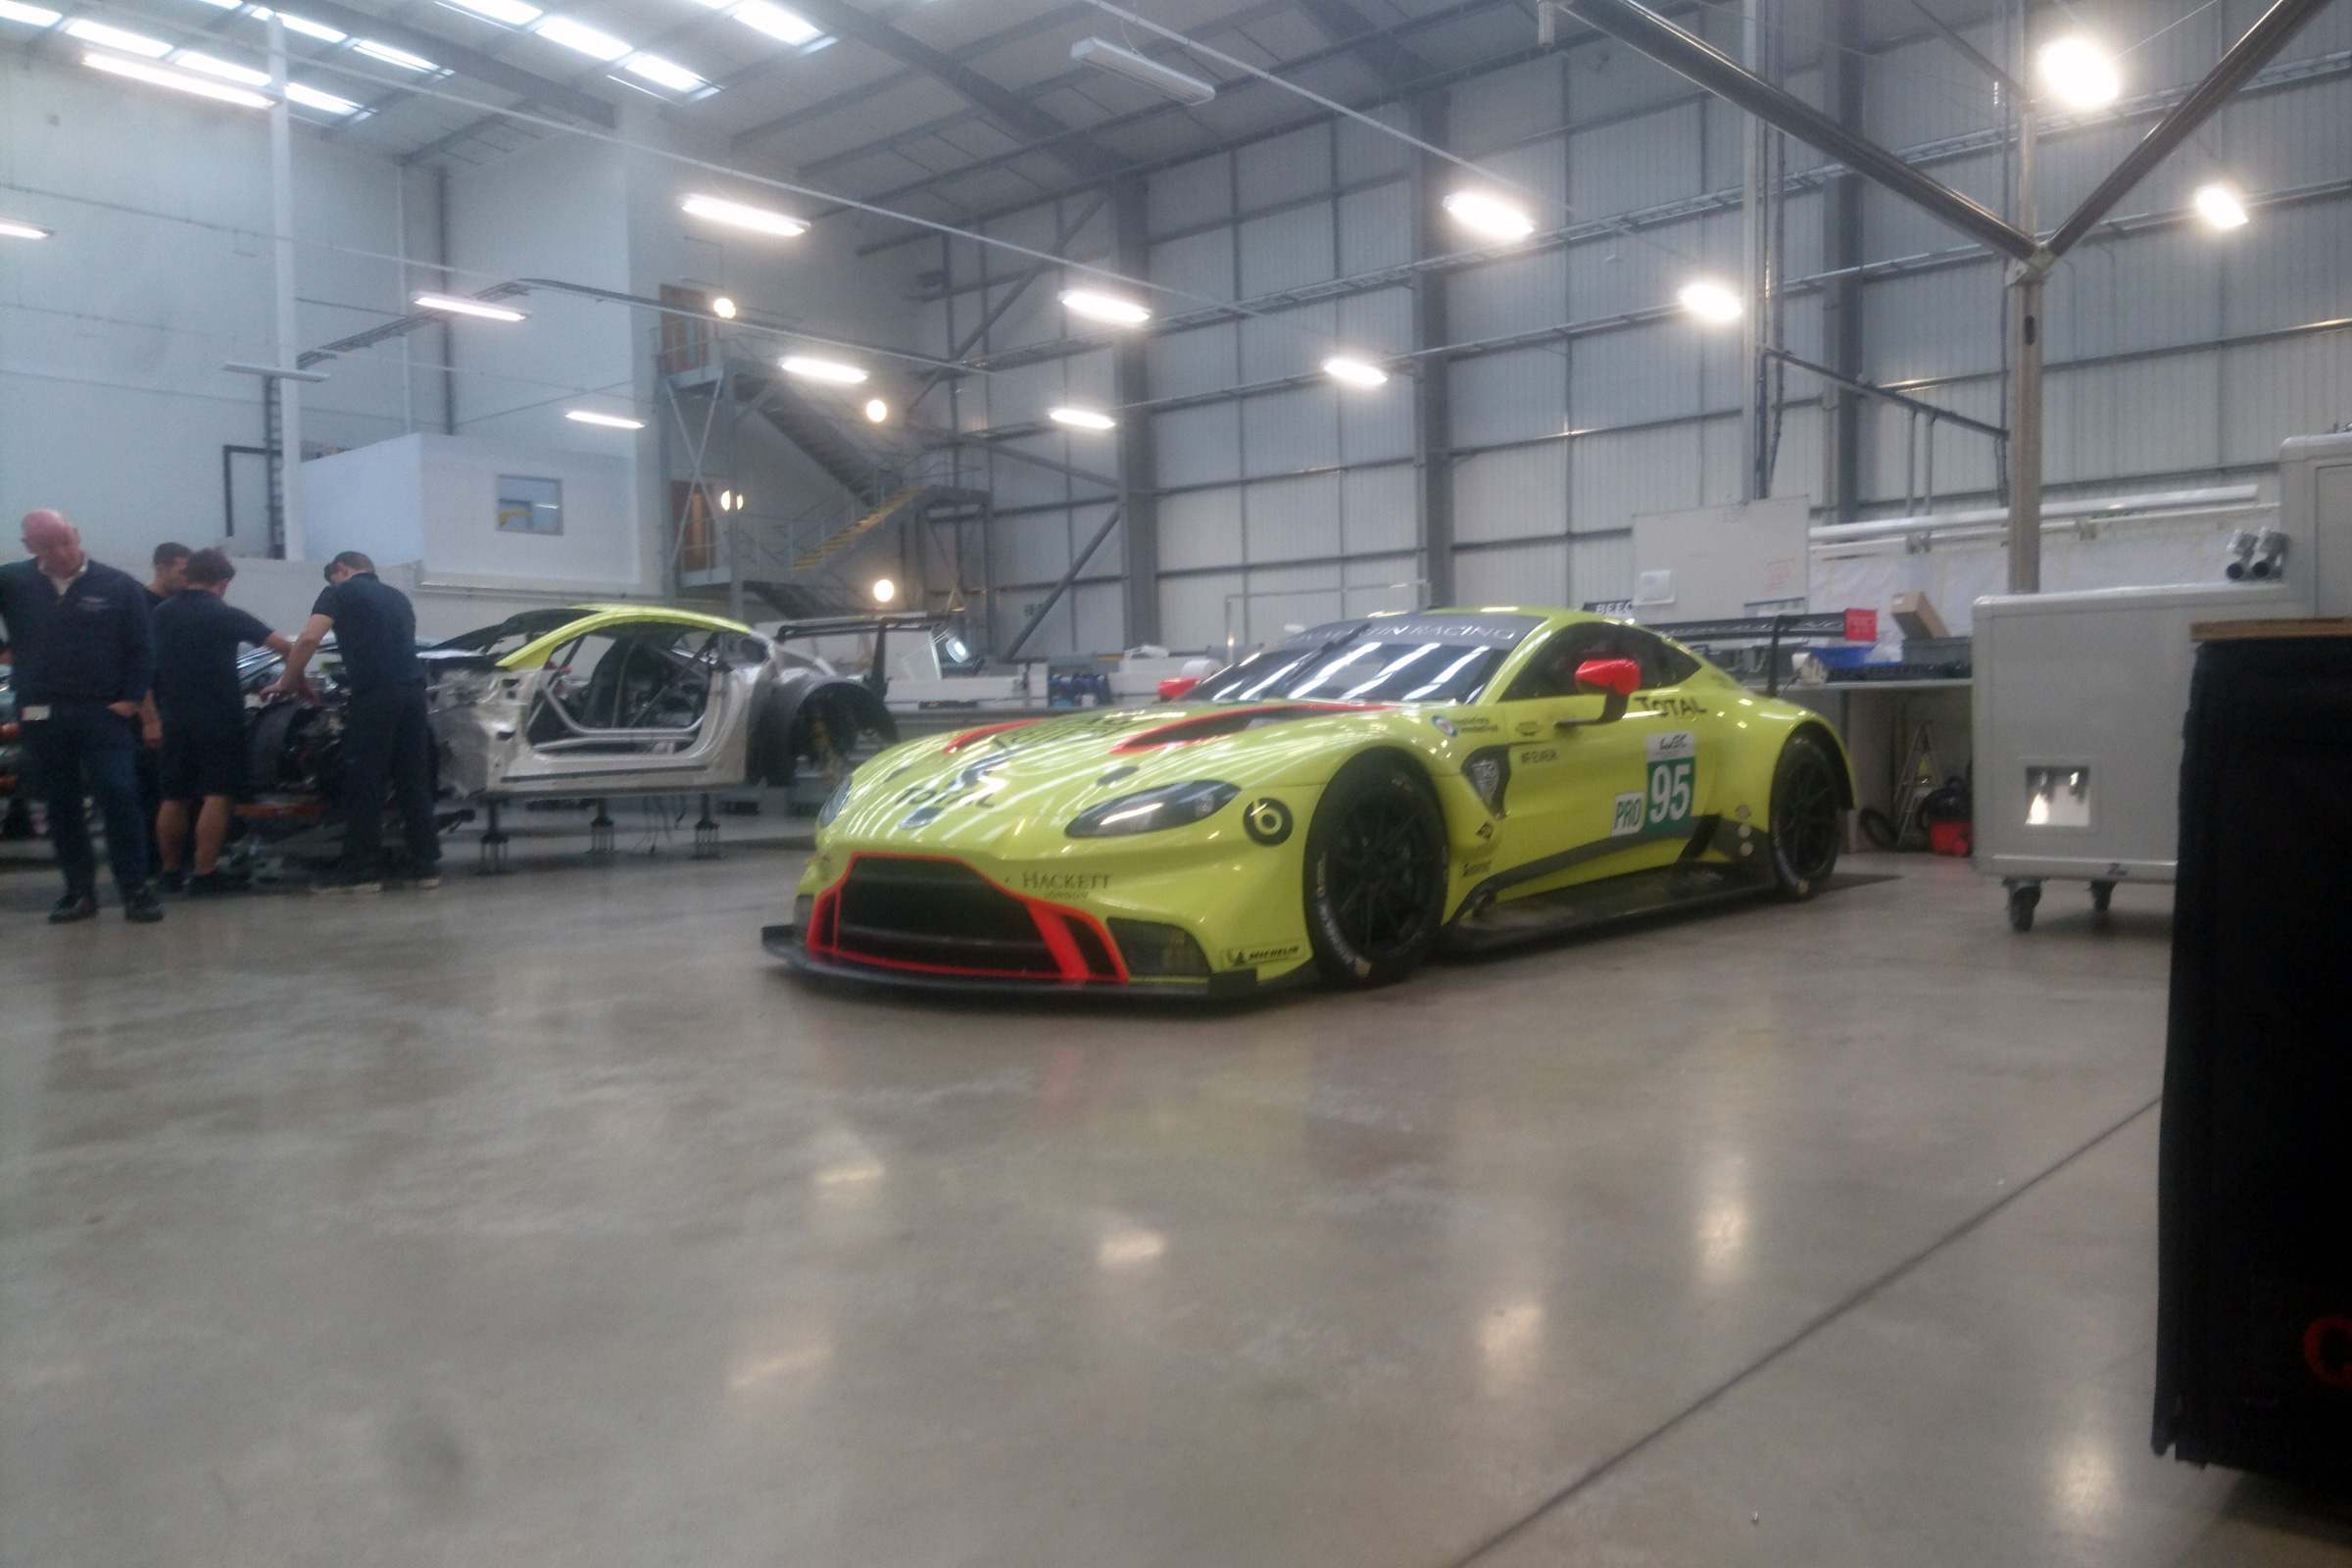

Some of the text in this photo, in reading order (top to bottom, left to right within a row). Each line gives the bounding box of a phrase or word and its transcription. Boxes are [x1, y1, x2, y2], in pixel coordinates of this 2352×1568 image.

[1633, 696, 1707, 717] TOTAL
[1649, 763, 1690, 823] 95
[1614, 799, 1641, 829] PRO
[1022, 871, 1111, 889] HACKETT
